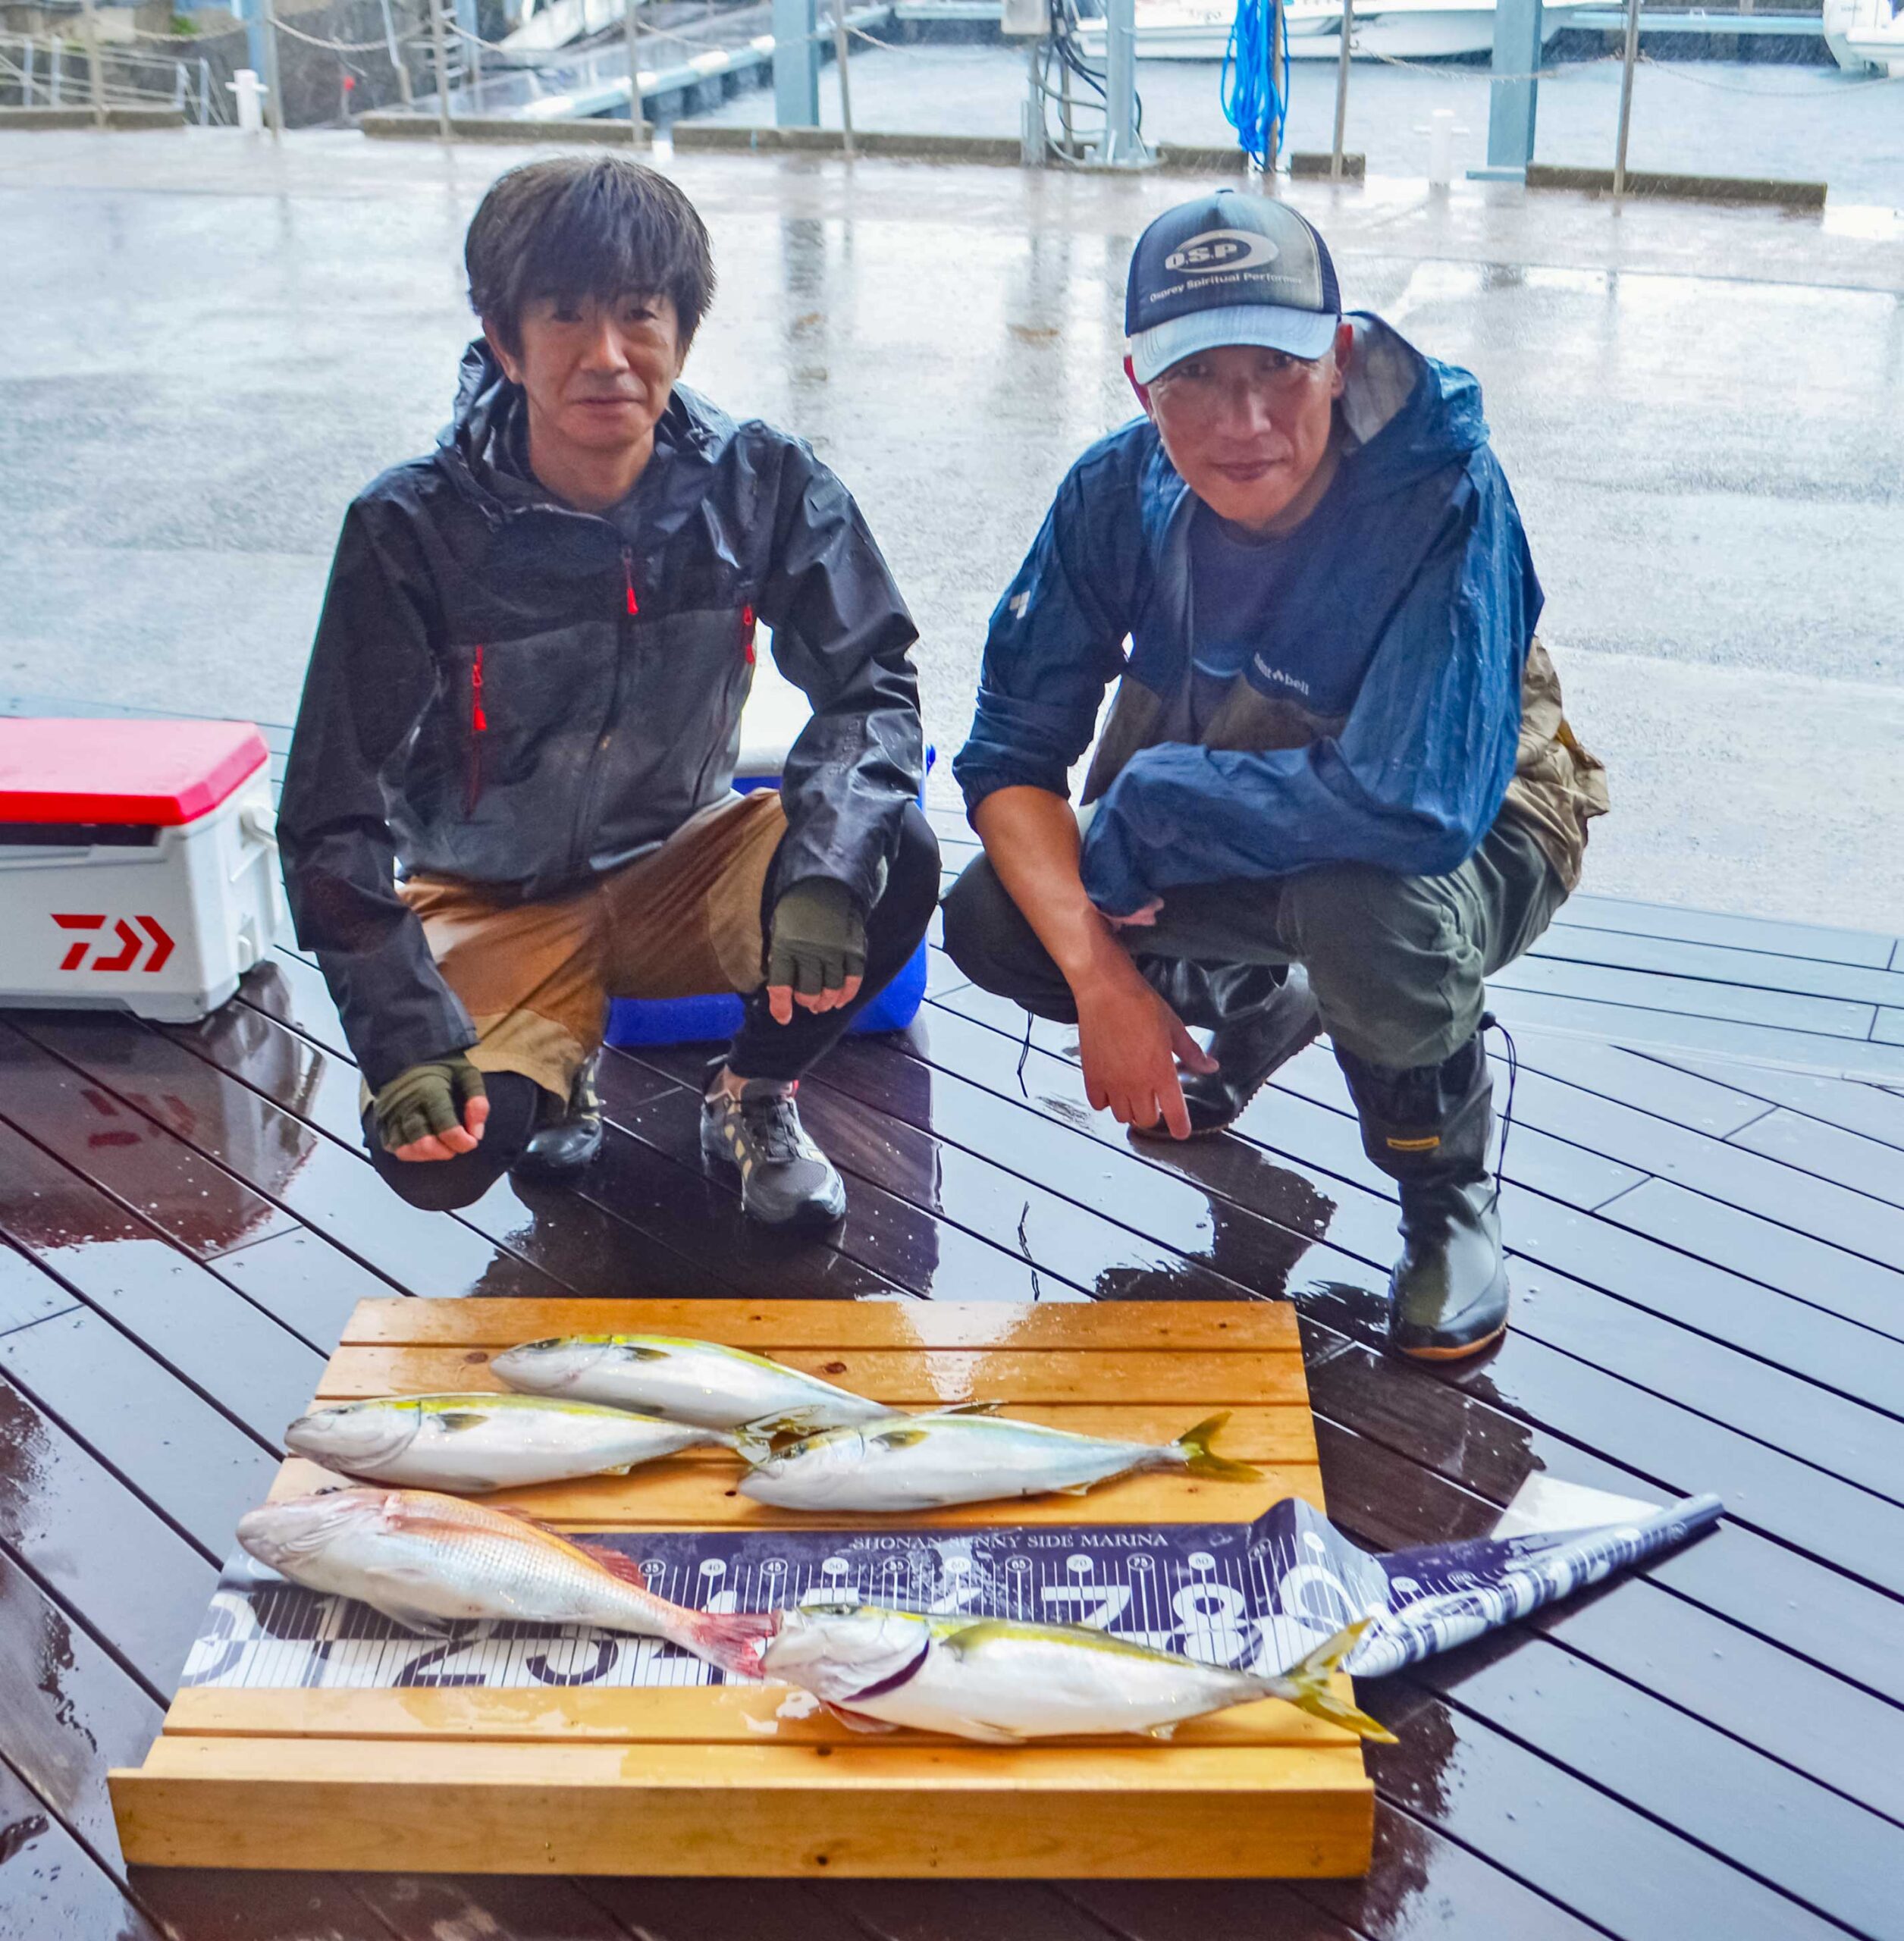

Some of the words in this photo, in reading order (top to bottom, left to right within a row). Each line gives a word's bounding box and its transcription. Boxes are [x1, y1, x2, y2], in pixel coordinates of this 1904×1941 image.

[1149, 284, 1184, 303] Osprey
[1187, 272, 1241, 290] Spiritual
[852, 1536, 942, 1551] SHONAN
[1027, 1533, 1074, 1548] SIDE
[1080, 1532, 1169, 1547] MARINA
